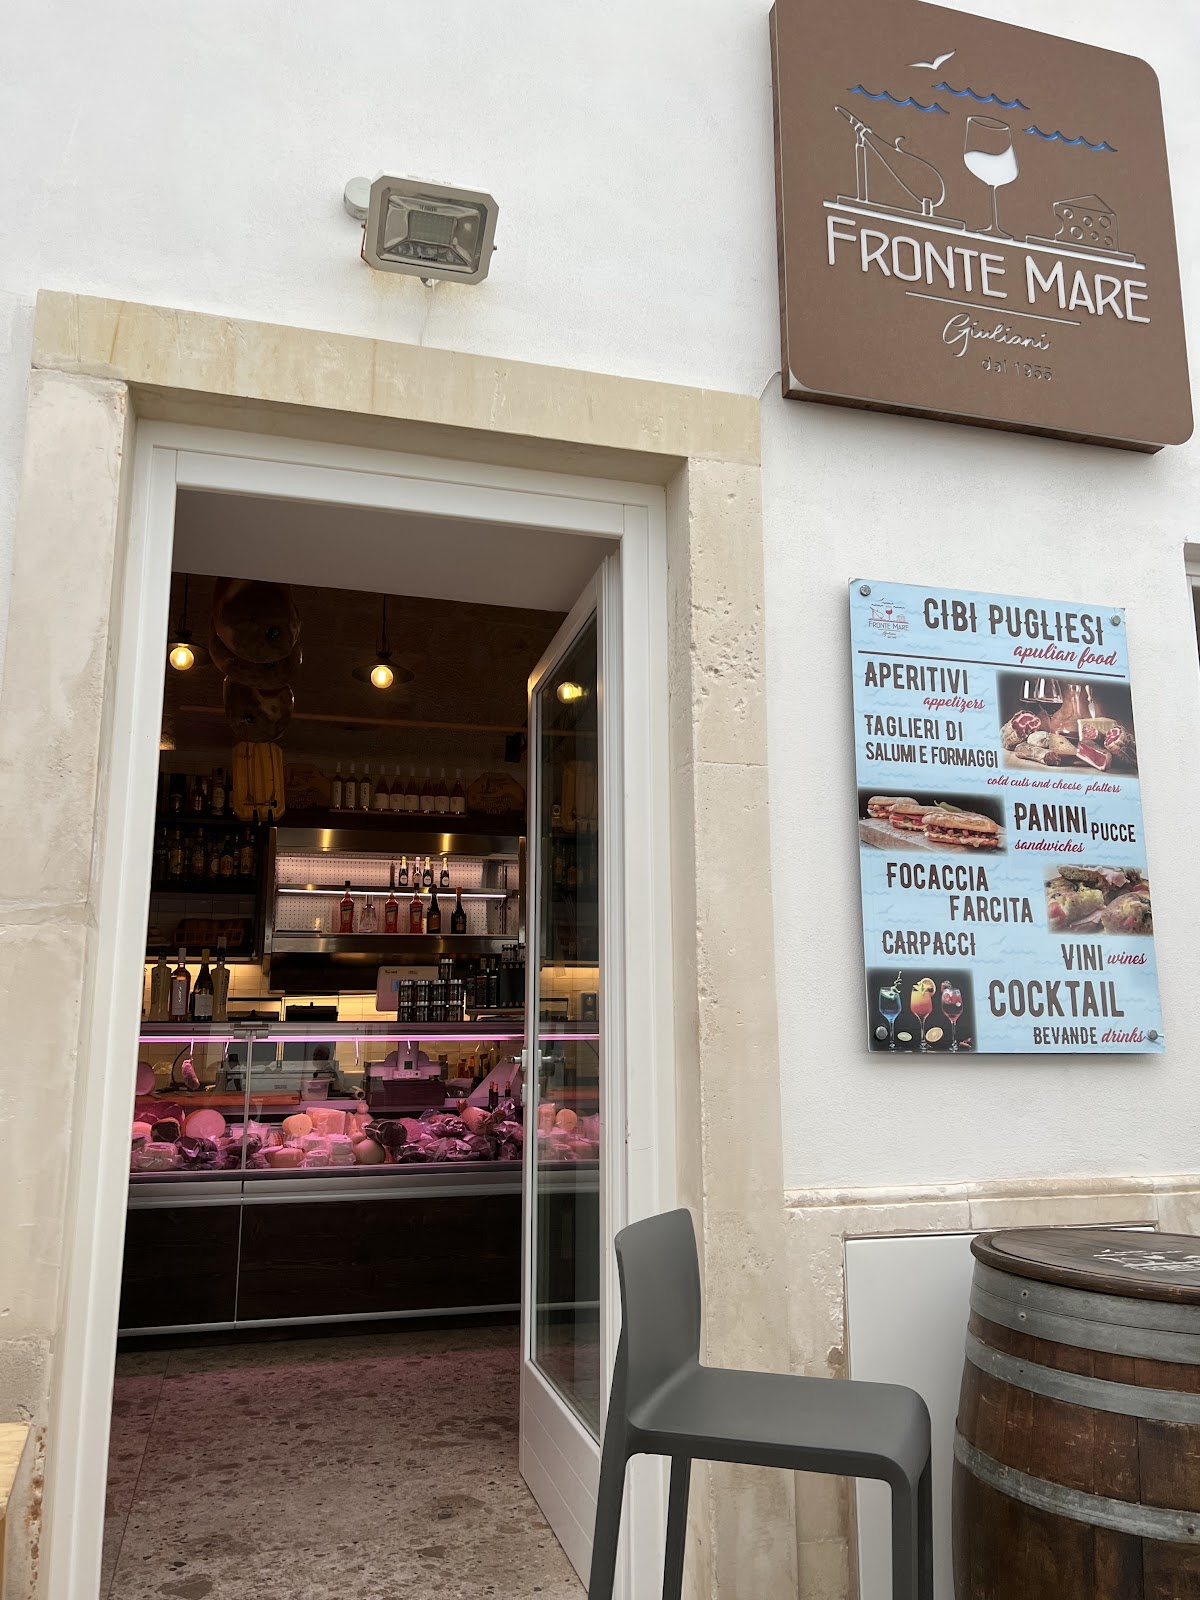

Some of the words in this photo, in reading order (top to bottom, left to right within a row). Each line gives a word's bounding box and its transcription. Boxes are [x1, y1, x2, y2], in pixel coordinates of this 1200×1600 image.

[827, 215, 1008, 299] FRONTE
[1025, 256, 1151, 324] MARE
[942, 312, 1050, 357] Giuliani
[981, 356, 1008, 375] dal
[1013, 360, 1053, 381] 1955
[868, 621, 891, 630] FRONTE
[892, 623, 909, 632] MARE
[923, 597, 978, 633] CIBI
[988, 606, 1104, 646] PUGLIESI
[1013, 643, 1078, 664] apulian
[1076, 647, 1118, 669] food
[864, 661, 969, 695] APERITIVI
[923, 695, 986, 714] appetizers
[864, 714, 940, 740] TAGLIERI
[946, 720, 964, 742] DI
[866, 742, 916, 764] SALUMI
[919, 746, 928, 764] E
[931, 747, 998, 769] FORMAGGI
[987, 776, 1009, 787] cold
[1010, 777, 1030, 788] cuts
[1031, 778, 1051, 789] and
[1051, 778, 1082, 791] cheese
[1084, 779, 1121, 794] platters
[1014, 802, 1088, 834] PANINI
[1090, 822, 1136, 843] PUCCE
[1014, 839, 1085, 853] sandwiches
[886, 862, 989, 892] FOCACCIA
[949, 895, 1034, 923] FARCITA
[882, 930, 976, 956] CARPACCI
[1061, 943, 1104, 971] VINI
[1107, 951, 1147, 966] wines
[987, 979, 1125, 1018] COCKTAIL
[1033, 1026, 1098, 1045] BEVANDE
[1101, 1027, 1146, 1044] drinks
